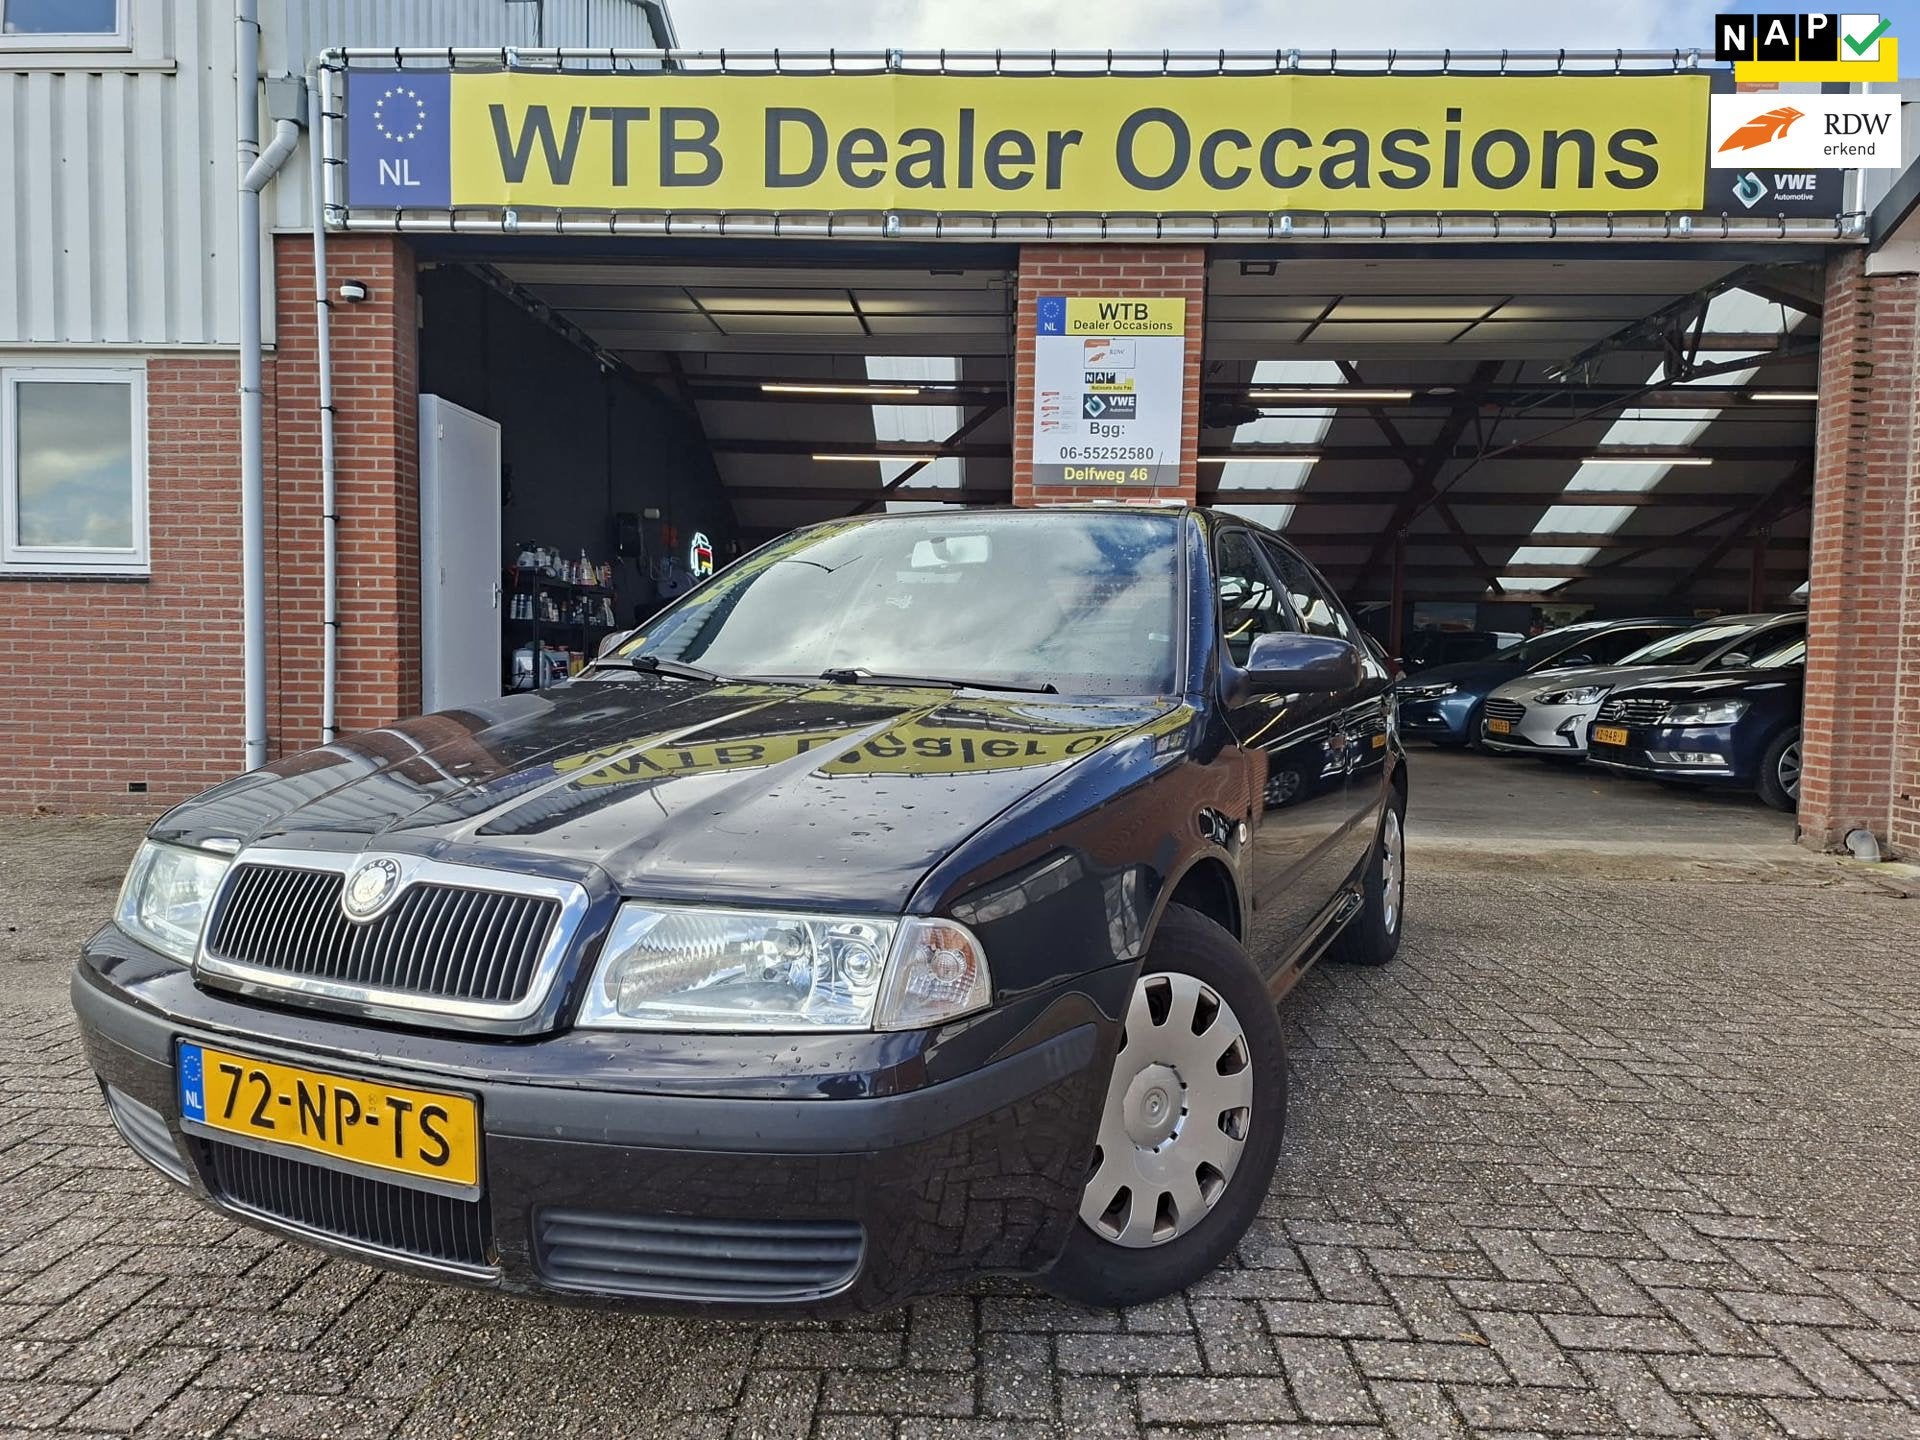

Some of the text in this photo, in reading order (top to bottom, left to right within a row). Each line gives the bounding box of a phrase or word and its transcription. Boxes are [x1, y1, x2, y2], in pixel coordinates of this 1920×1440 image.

[488, 103, 1661, 192] WTB Dealer Occasions
[378, 159, 420, 187] NL
[1774, 174, 1817, 190] VWE
[1774, 193, 1814, 201] Automotive
[1099, 303, 1149, 321] WTB
[1043, 322, 1057, 331] NL
[1073, 320, 1173, 331] Dealer Occasions
[1086, 372, 1114, 382] NAP
[1109, 396, 1135, 406] VWE
[1090, 422, 1125, 437] Bgg:
[1060, 447, 1154, 460] 06-55252580
[1064, 467, 1148, 483] Delfweg 46
[185, 1089, 202, 1109] NL
[219, 1062, 451, 1167] 72-NP-TS
